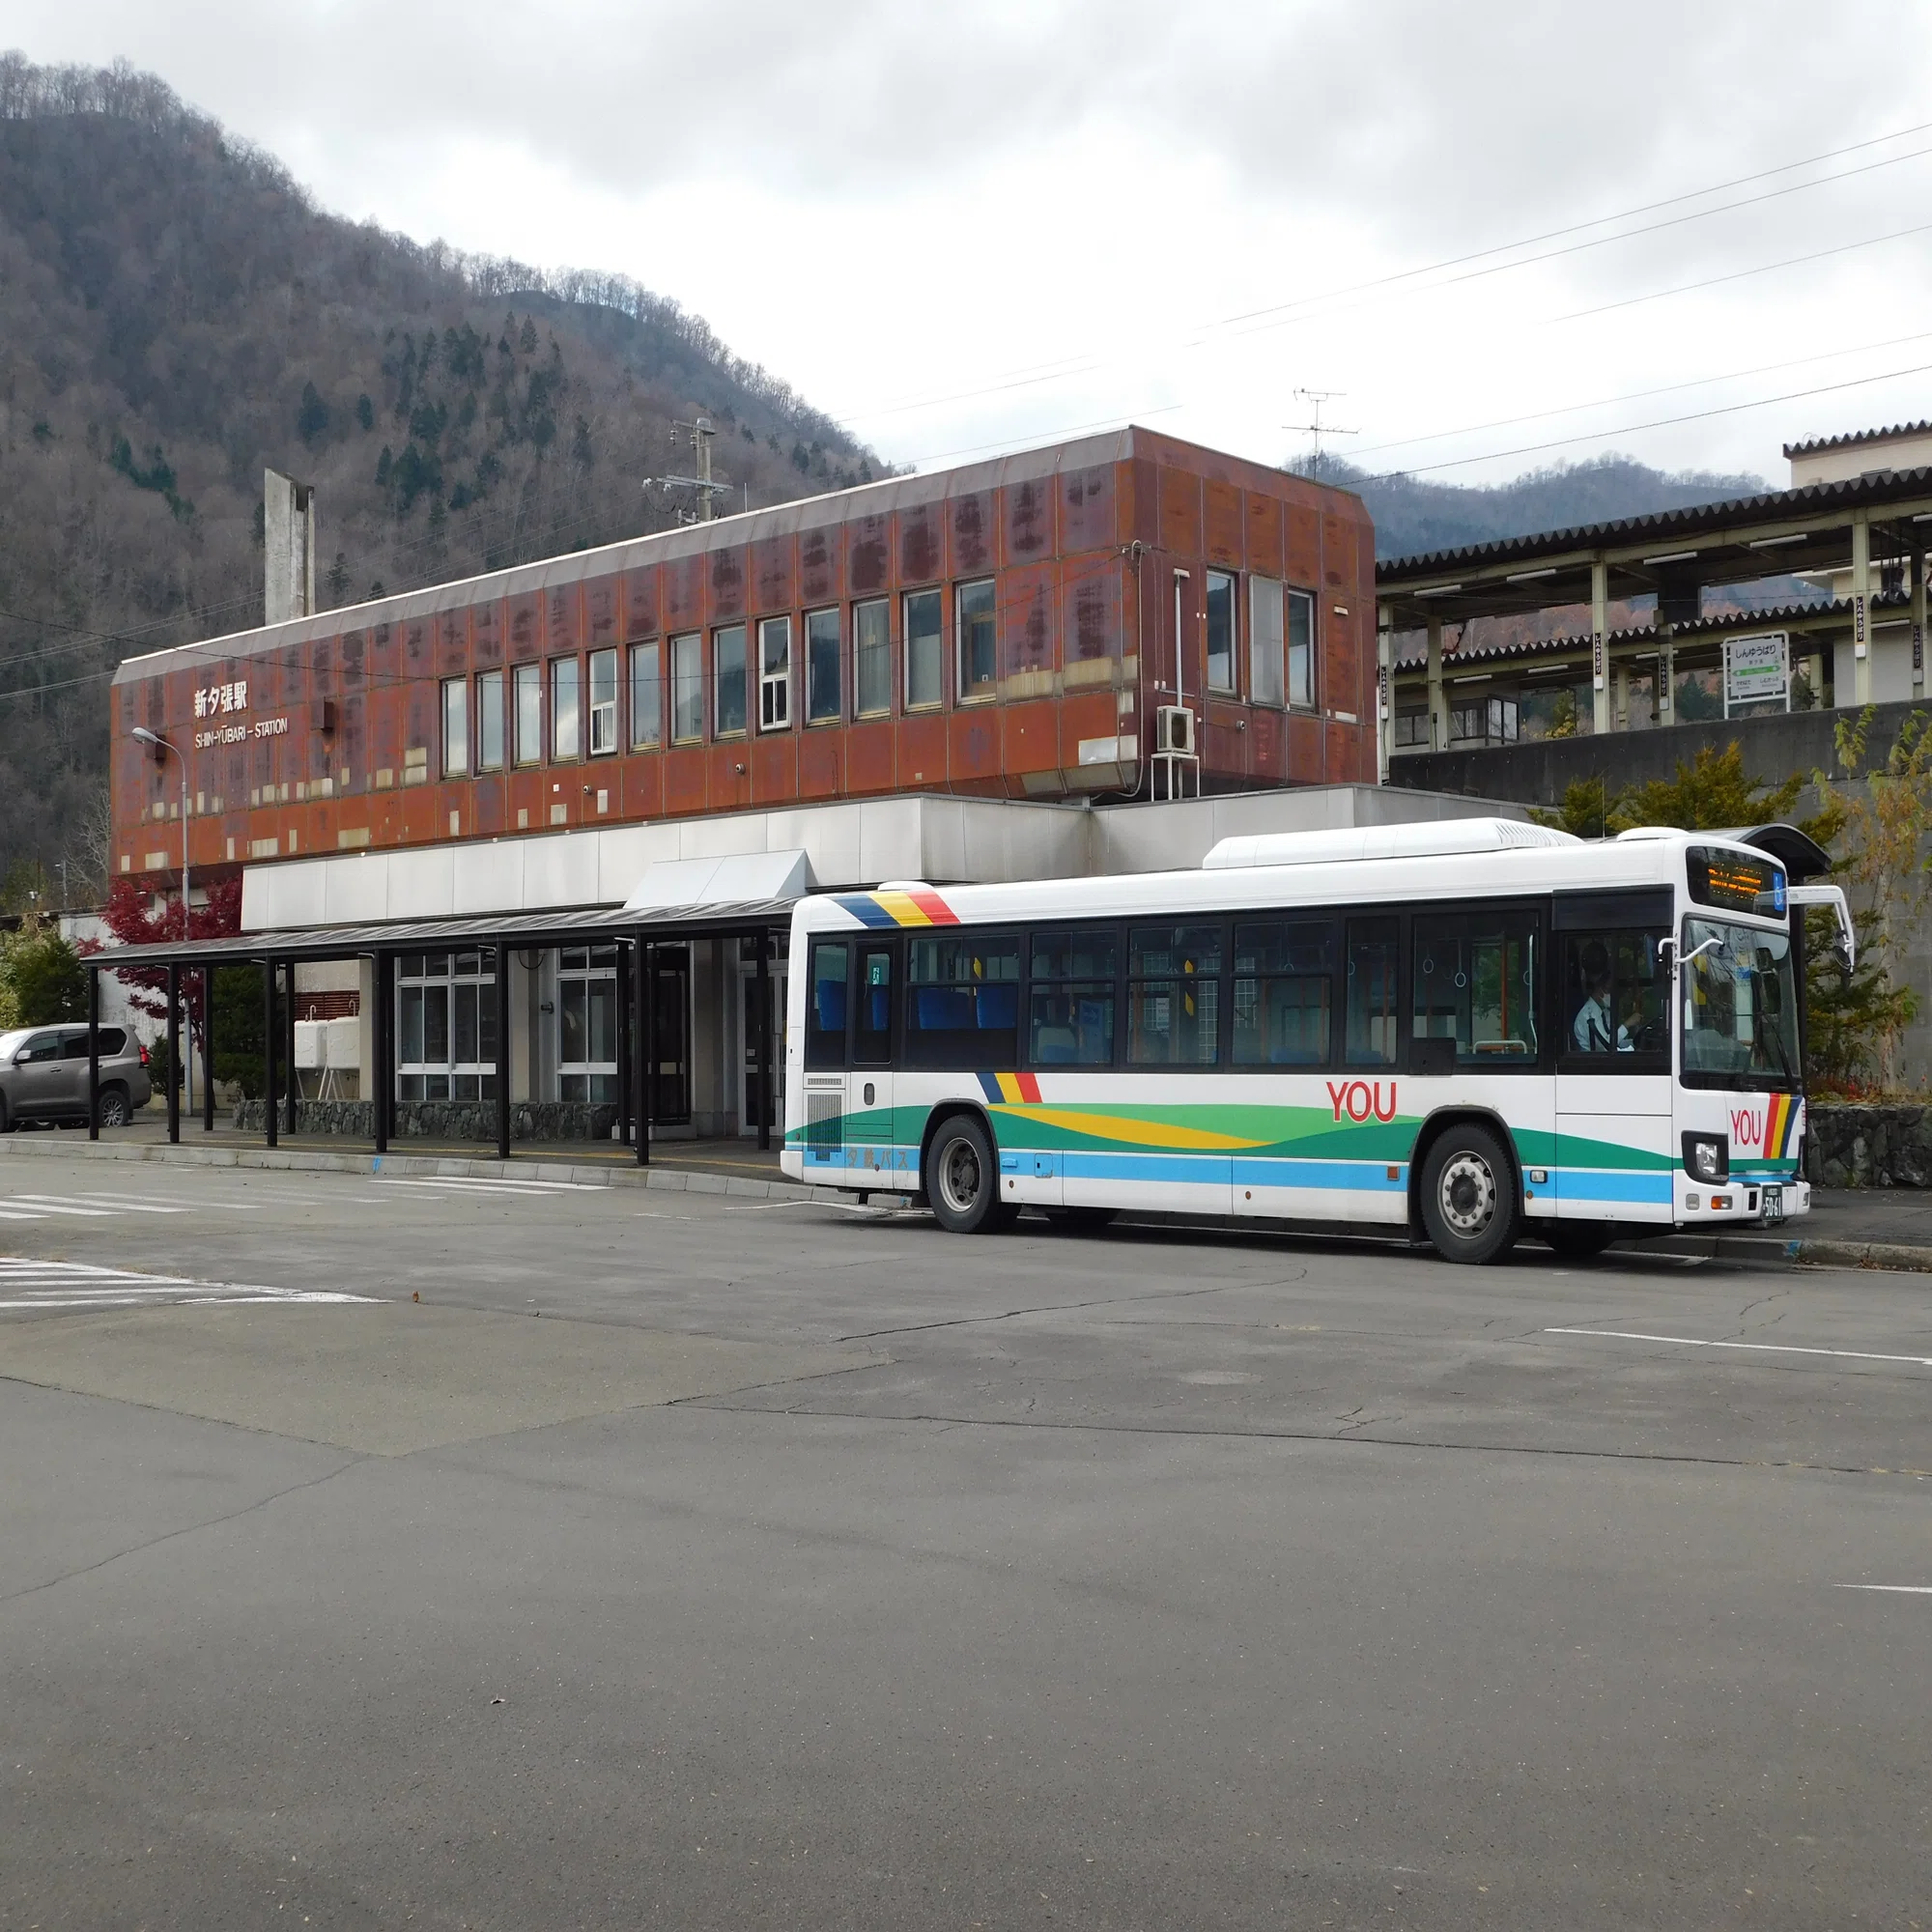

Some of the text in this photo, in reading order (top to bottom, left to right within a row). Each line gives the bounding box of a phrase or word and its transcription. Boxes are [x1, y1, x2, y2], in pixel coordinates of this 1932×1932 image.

[1736, 644, 1776, 659] しんゆうばり
[194, 680, 247, 719] 新夕張駅
[1325, 1081, 1398, 1123] YOU
[1730, 1109, 1761, 1146] YOU
[1765, 1196, 1781, 1217] 50-61
